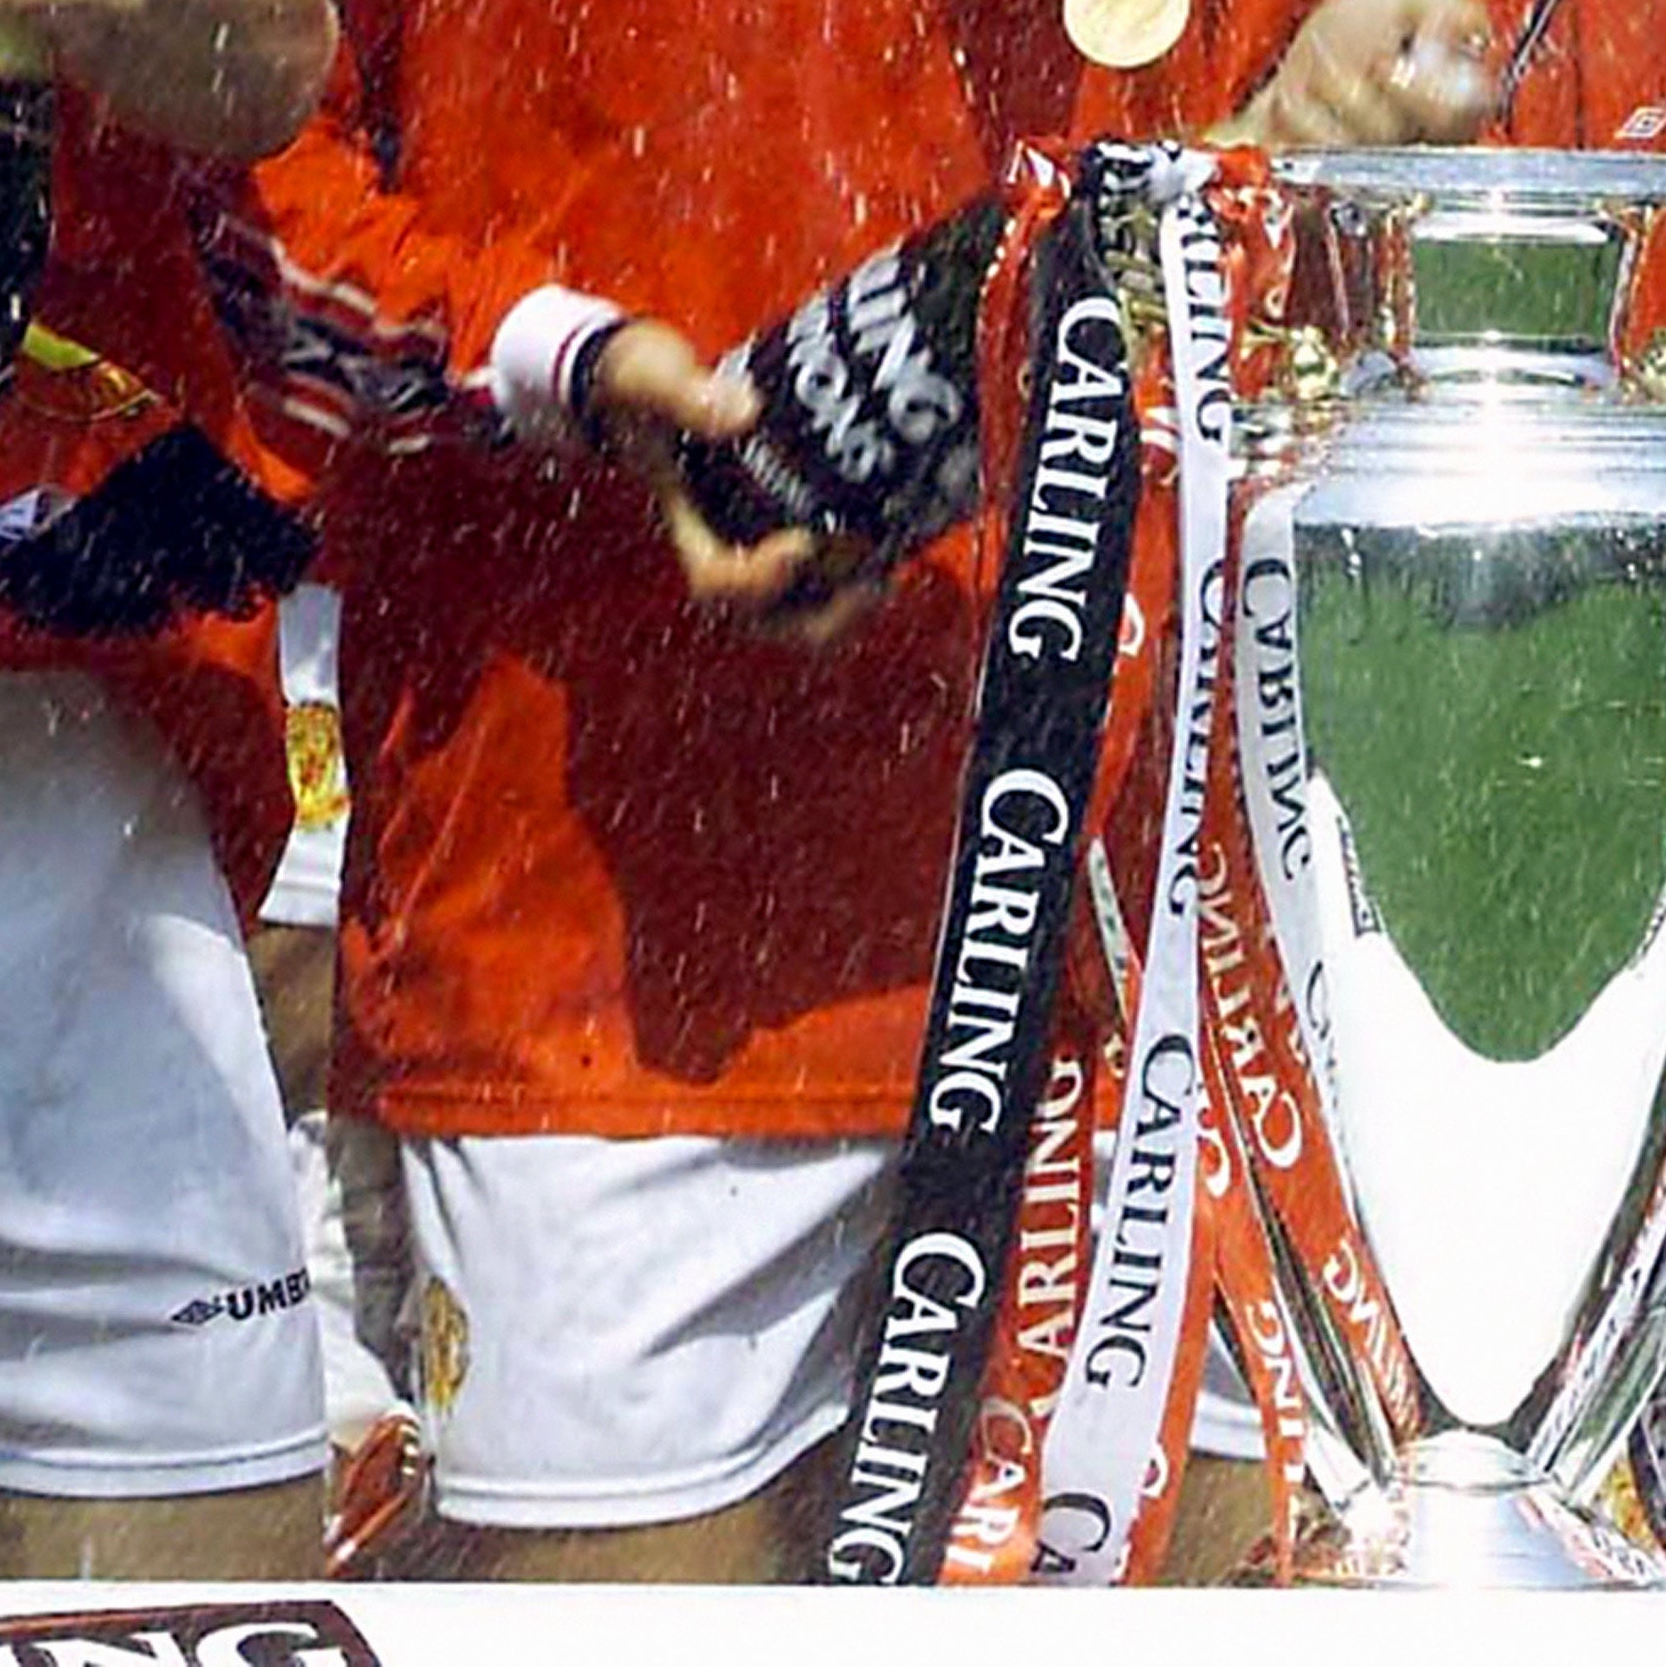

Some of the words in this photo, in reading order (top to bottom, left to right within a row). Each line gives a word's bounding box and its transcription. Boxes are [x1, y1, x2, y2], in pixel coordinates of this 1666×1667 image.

[1008, 295, 1128, 662] CARLING
[930, 768, 1069, 1137] CARLING
[1085, 1034, 1196, 1390] CARLING
[830, 1231, 986, 1585] CARLING
